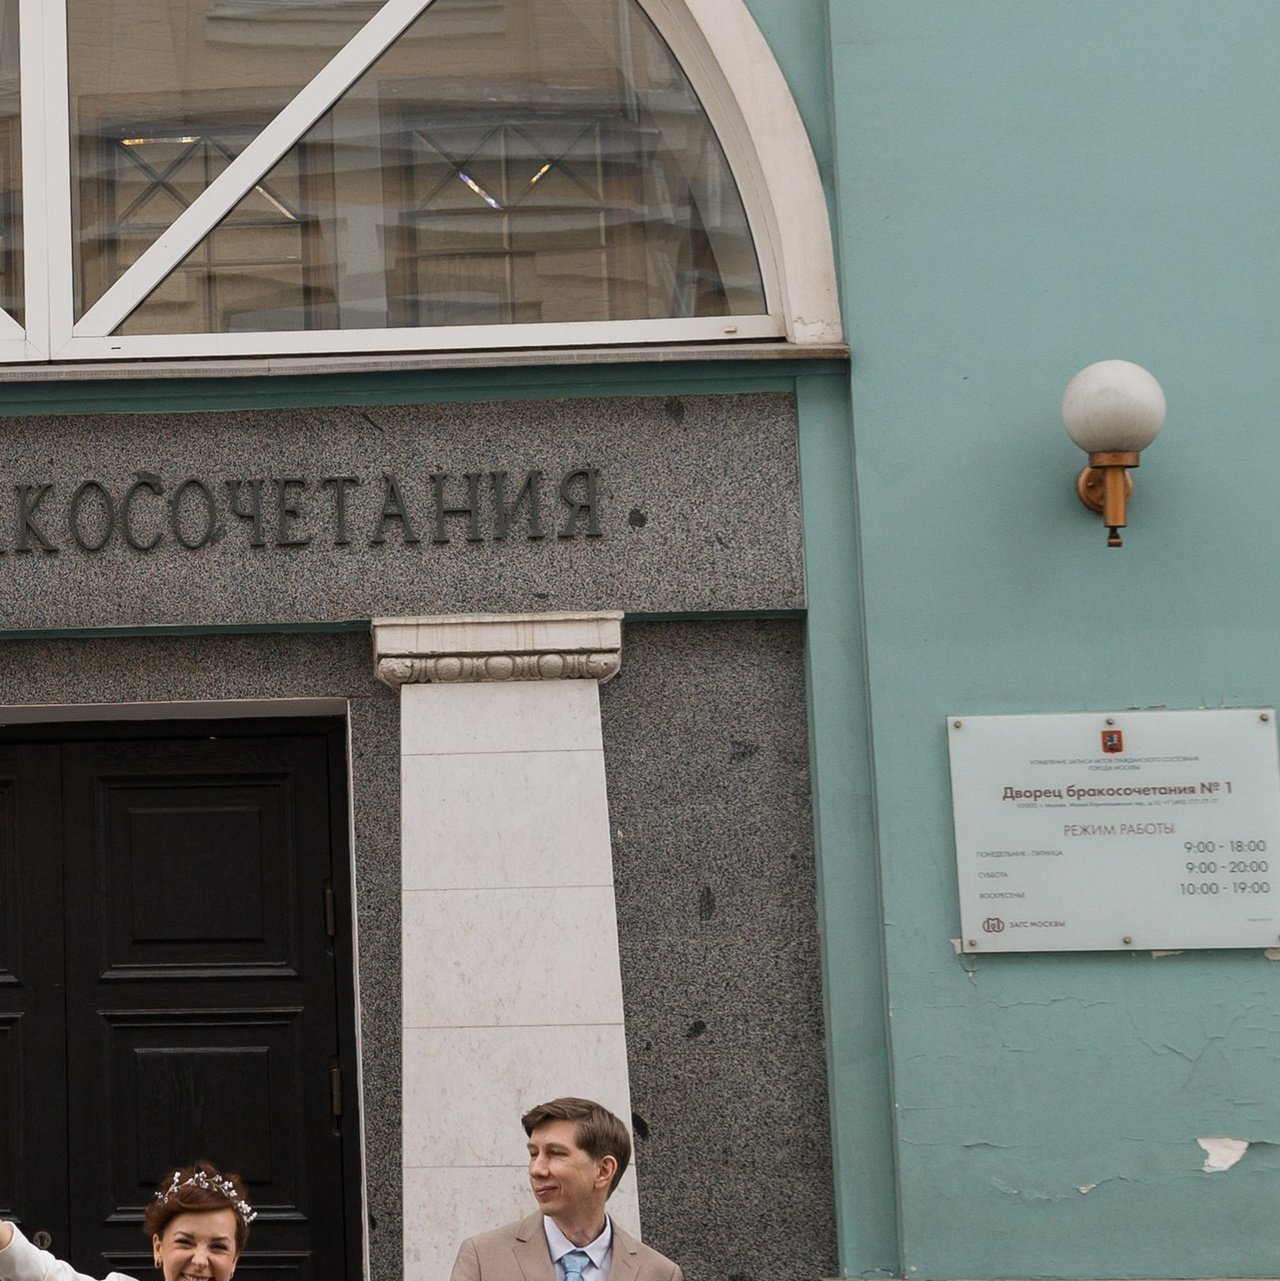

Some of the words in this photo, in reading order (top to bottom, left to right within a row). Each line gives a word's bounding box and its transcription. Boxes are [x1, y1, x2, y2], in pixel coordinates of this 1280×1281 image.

[1002, 786, 1063, 802] Дворец
[1066, 784, 1196, 801] бракосочетания
[1200, 781, 1220, 794] №
[1225, 781, 1232, 794] 1
[1063, 824, 1116, 837] РЕЖИМ
[1120, 822, 1175, 835] РАБОТЫ
[1183, 841, 1216, 853] 9:00
[1229, 839, 1267, 853] 18:00
[1185, 861, 1218, 874] 9:00
[1228, 860, 1269, 873] 20:00
[1180, 882, 1219, 895] 10:00
[1232, 881, 1271, 894] 19:00
[1008, 920, 1029, 928] ЗАГС
[1030, 920, 1066, 928] МОСКВЫ
